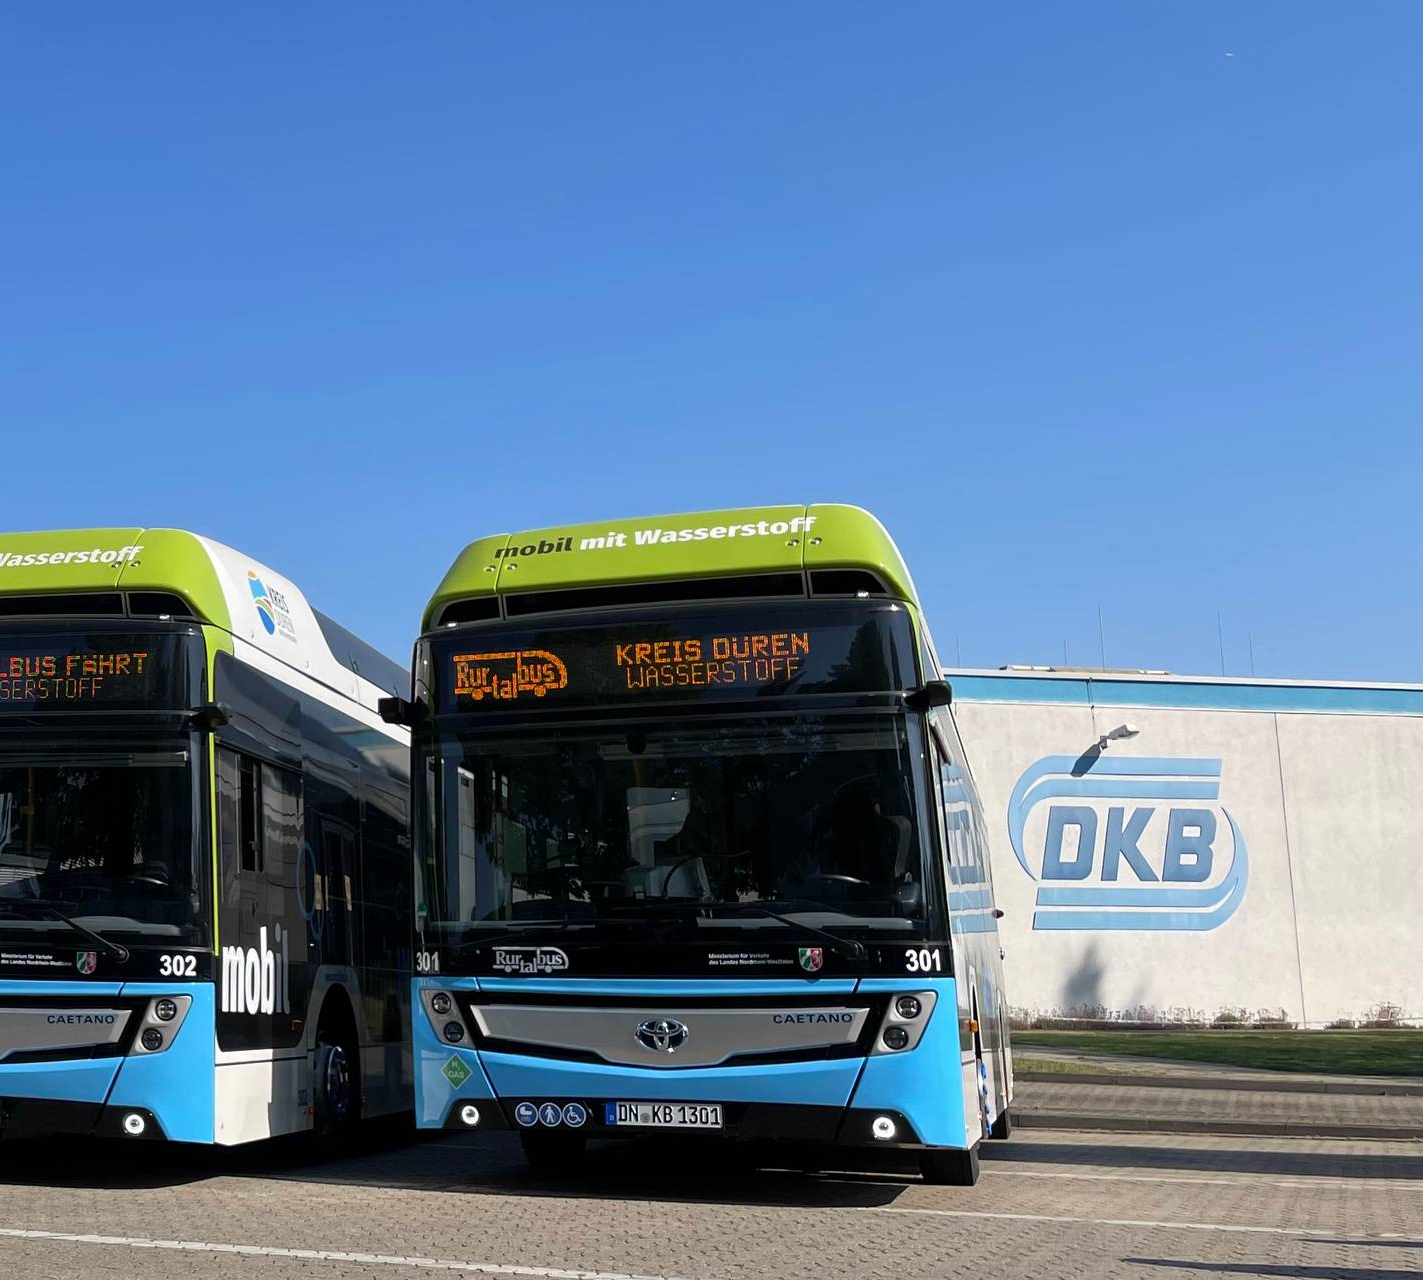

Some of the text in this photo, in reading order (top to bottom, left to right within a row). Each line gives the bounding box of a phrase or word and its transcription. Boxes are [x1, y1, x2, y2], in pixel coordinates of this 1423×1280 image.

[494, 516, 816, 558] mobil mit Wasserstoff
[616, 632, 809, 666] KREIS DÜREN
[66, 653, 147, 676] FÄHRT
[626, 657, 799, 689] WASSERSTOFF
[1041, 805, 1217, 882] DKB
[159, 955, 197, 976] 302
[221, 922, 290, 1014] mobil
[416, 951, 439, 972] 301
[905, 949, 941, 972] 301
[47, 1015, 114, 1024] CAETANO
[773, 1013, 853, 1024] CAETANO
[448, 1071, 465, 1079] GAS
[618, 1104, 638, 1122] DN
[652, 1105, 673, 1124] KB
[678, 1106, 720, 1125] 1301
